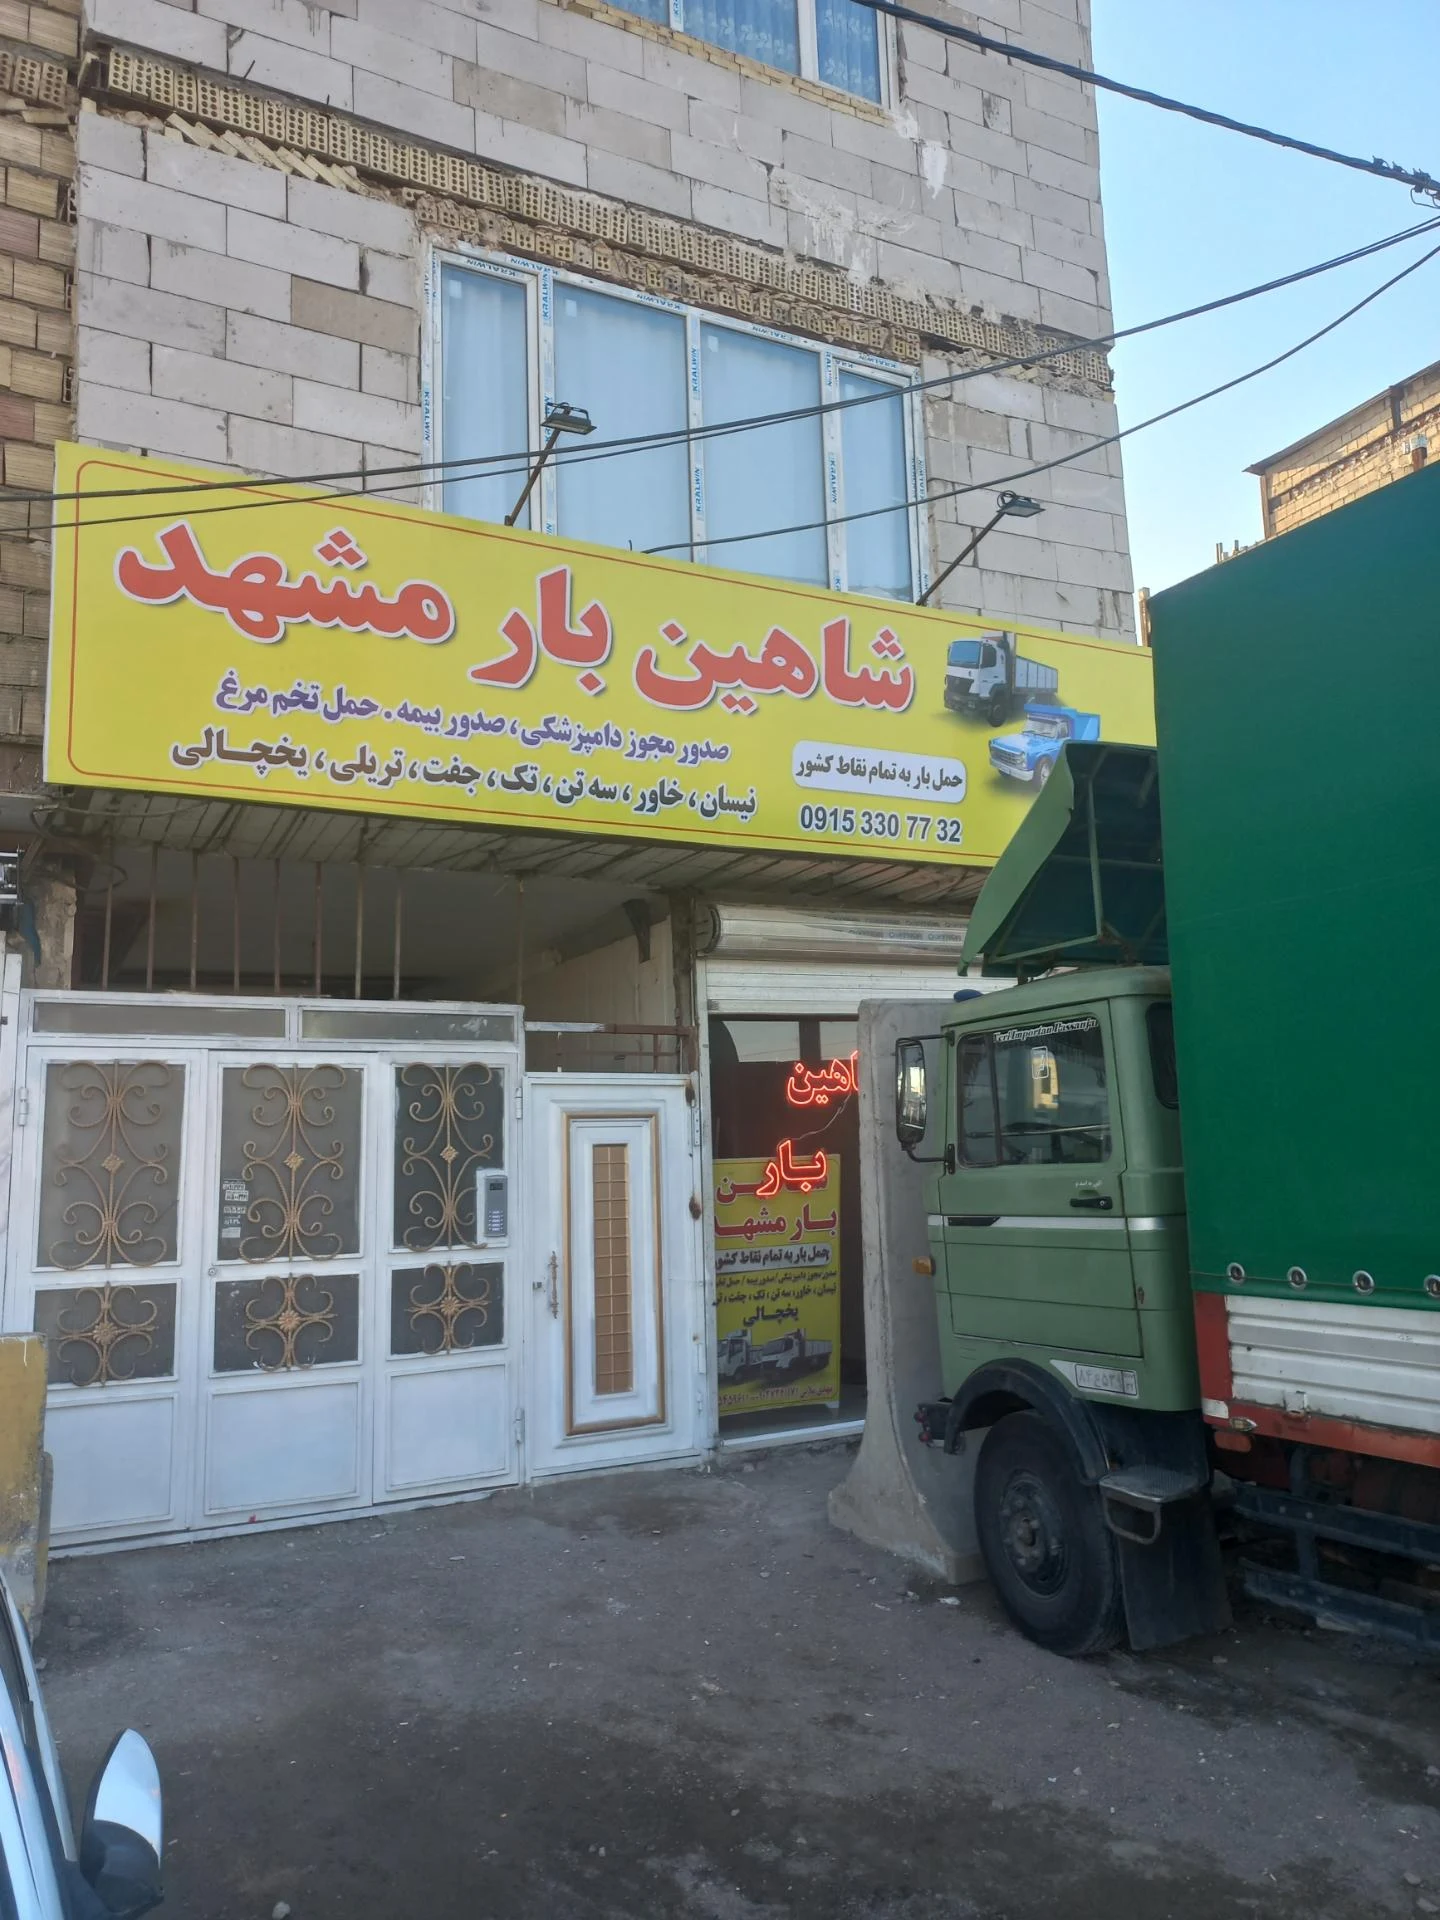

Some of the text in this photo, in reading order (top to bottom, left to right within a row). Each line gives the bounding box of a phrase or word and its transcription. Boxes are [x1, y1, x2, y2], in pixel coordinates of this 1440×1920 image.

[466, 258, 516, 277] KRALWIN
[542, 273, 550, 318] KRALWIN
[637, 293, 681, 310] KRALWIN
[825, 351, 833, 387] RALWIN
[423, 390, 431, 442] KRALWIN
[694, 466, 702, 512] KRALWIN
[830, 459, 838, 504] KRALWIN
[114, 520, 915, 715] شاهین بار مشهد
[215, 670, 268, 711] مرغ
[271, 681, 319, 715] تخم
[323, 686, 379, 721] حمل
[444, 711, 506, 737] صدور
[173, 727, 307, 776] یخچالی
[625, 730, 675, 760] مجوز
[677, 741, 730, 765] صدور
[588, 777, 617, 800] سه
[795, 753, 963, 791] حمل بار به تمام نقاط کشور
[800, 804, 961, 843] 0915 330 77 32
[756, 1139, 827, 1195] بار
[789, 1203, 838, 1241] بار
